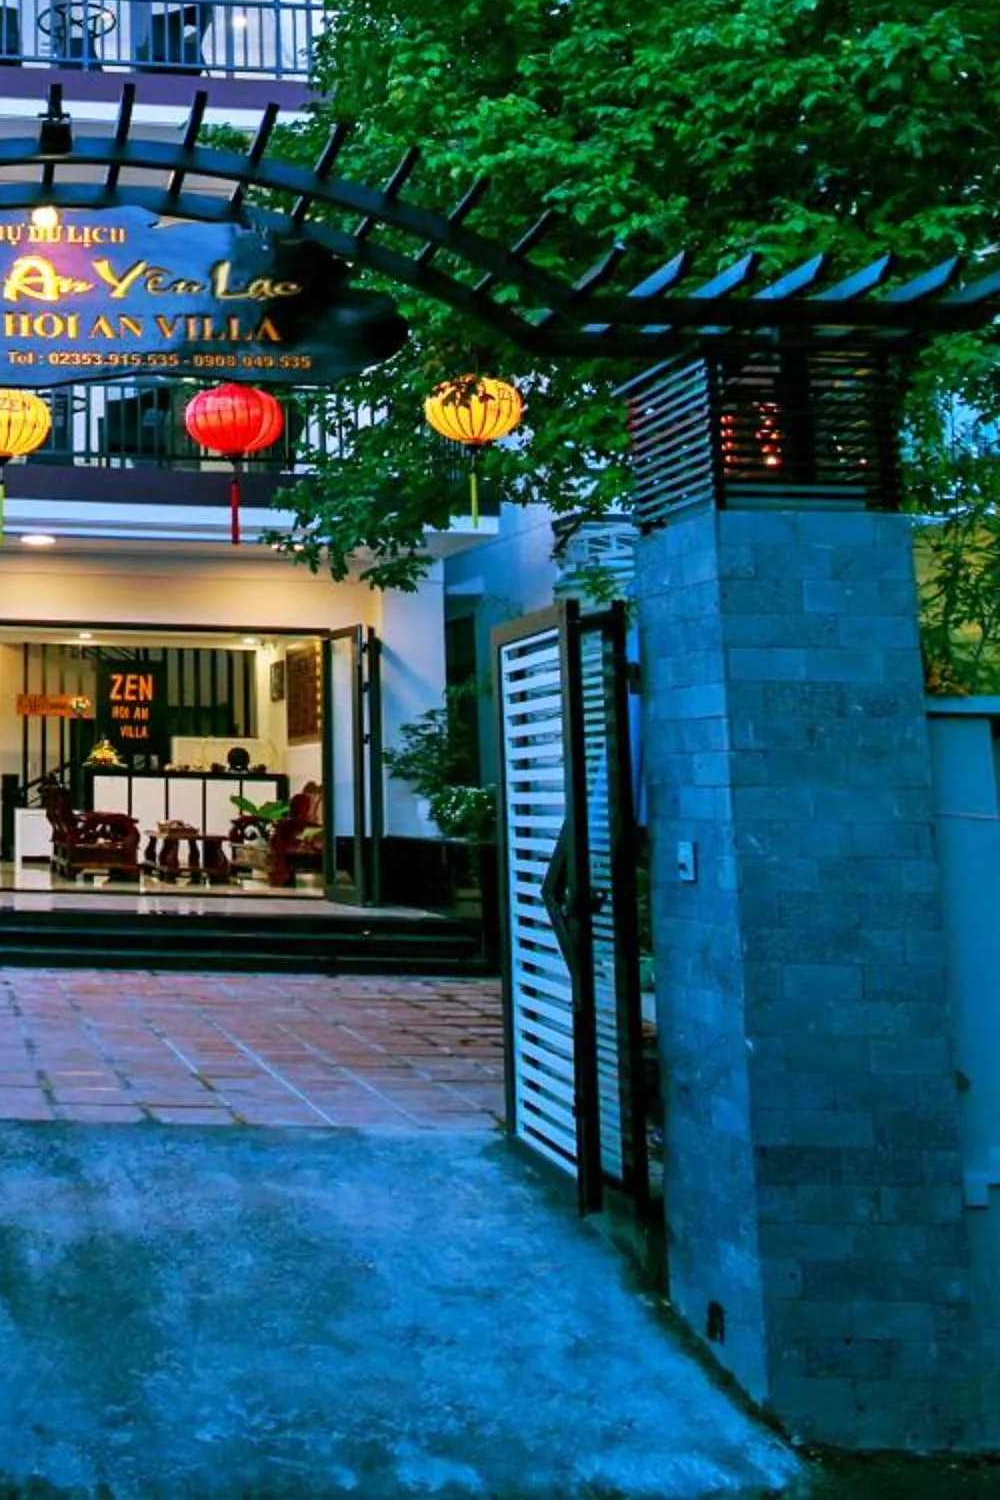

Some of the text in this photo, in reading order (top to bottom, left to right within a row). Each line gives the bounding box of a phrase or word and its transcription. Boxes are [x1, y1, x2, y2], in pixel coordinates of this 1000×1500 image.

[28, 225, 62, 243] DU
[67, 225, 125, 247] LỊCH
[3, 255, 94, 301] An
[3, 312, 79, 338] HOI
[89, 314, 144, 340] AN
[154, 315, 282, 342] VILLA
[109, 674, 153, 700] ZEN
[120, 726, 149, 738] VILLA
